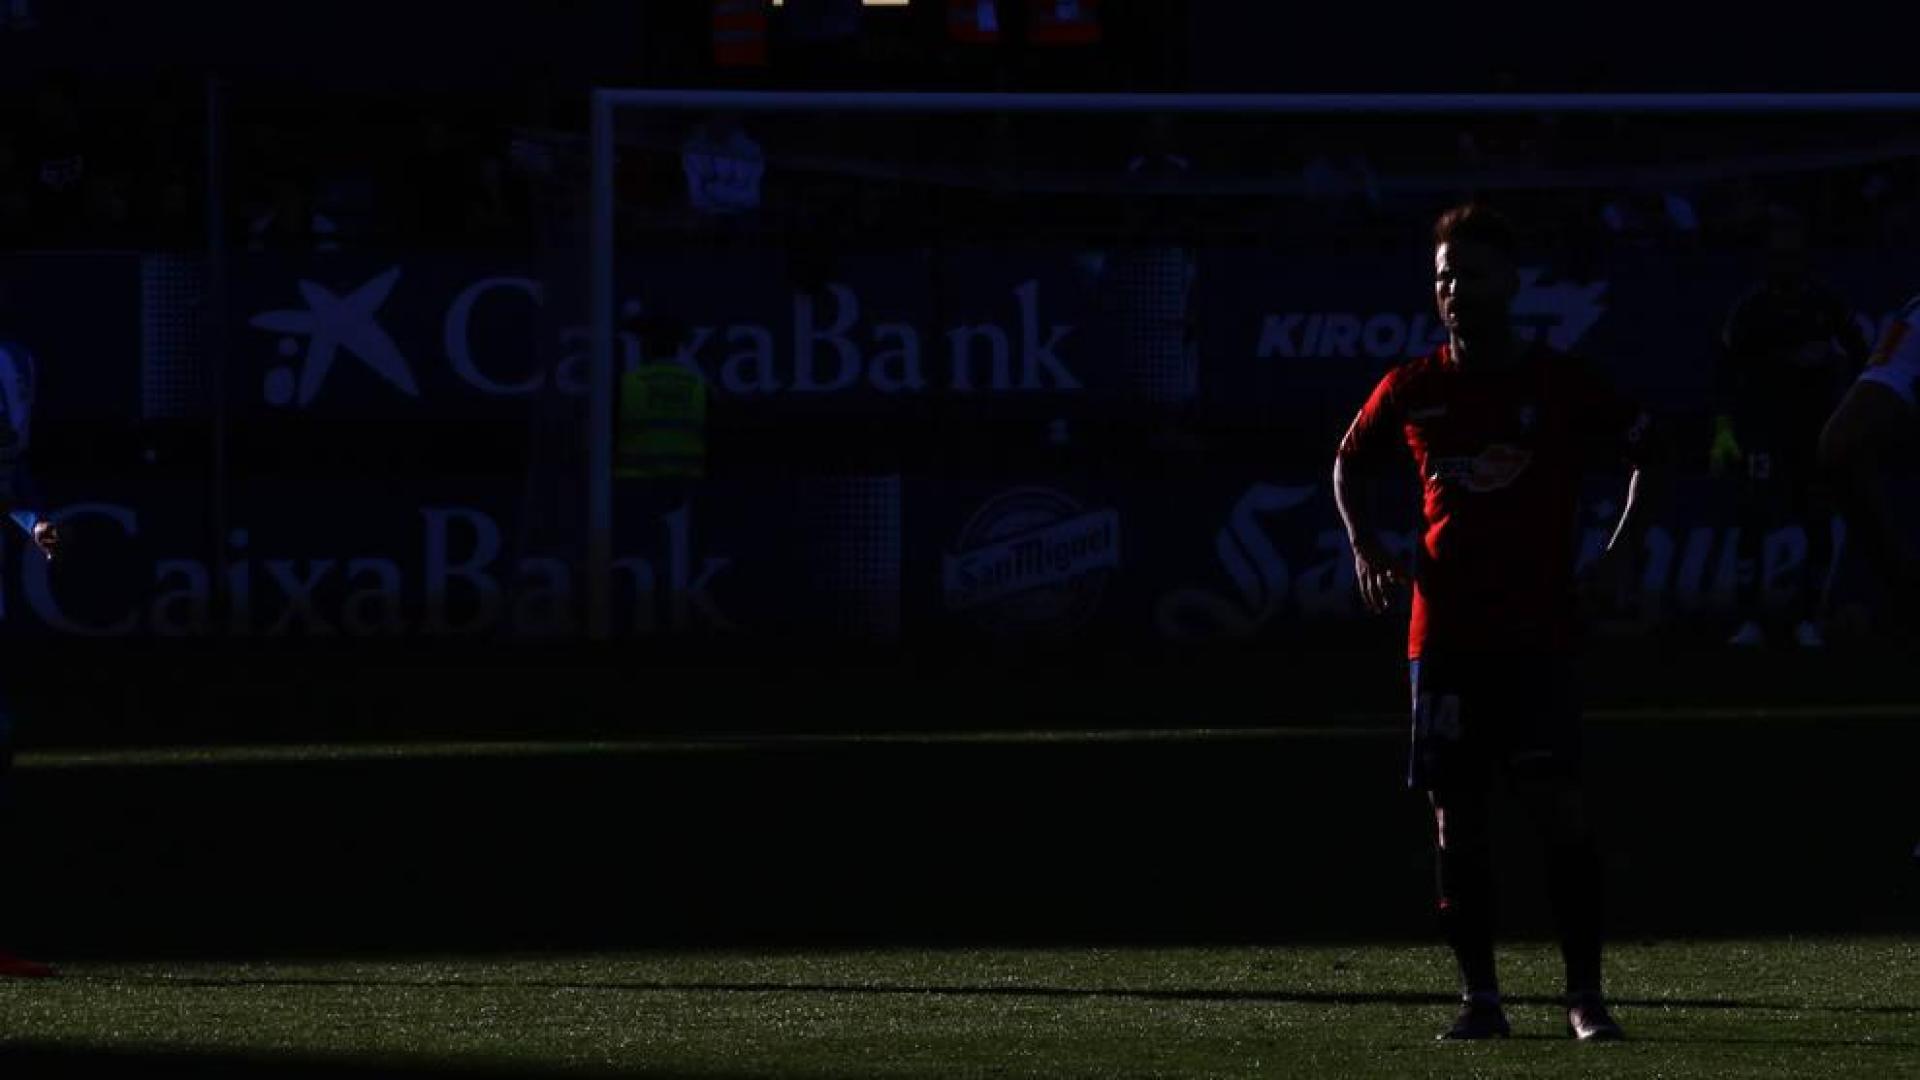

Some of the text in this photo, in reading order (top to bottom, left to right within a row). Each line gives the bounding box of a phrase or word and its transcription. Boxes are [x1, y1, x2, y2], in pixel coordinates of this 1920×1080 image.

[1256, 311, 1448, 358] KIROL
[1748, 452, 1770, 481] 13
[22, 501, 737, 637] CaixaBank
[1418, 691, 1464, 743] 14
